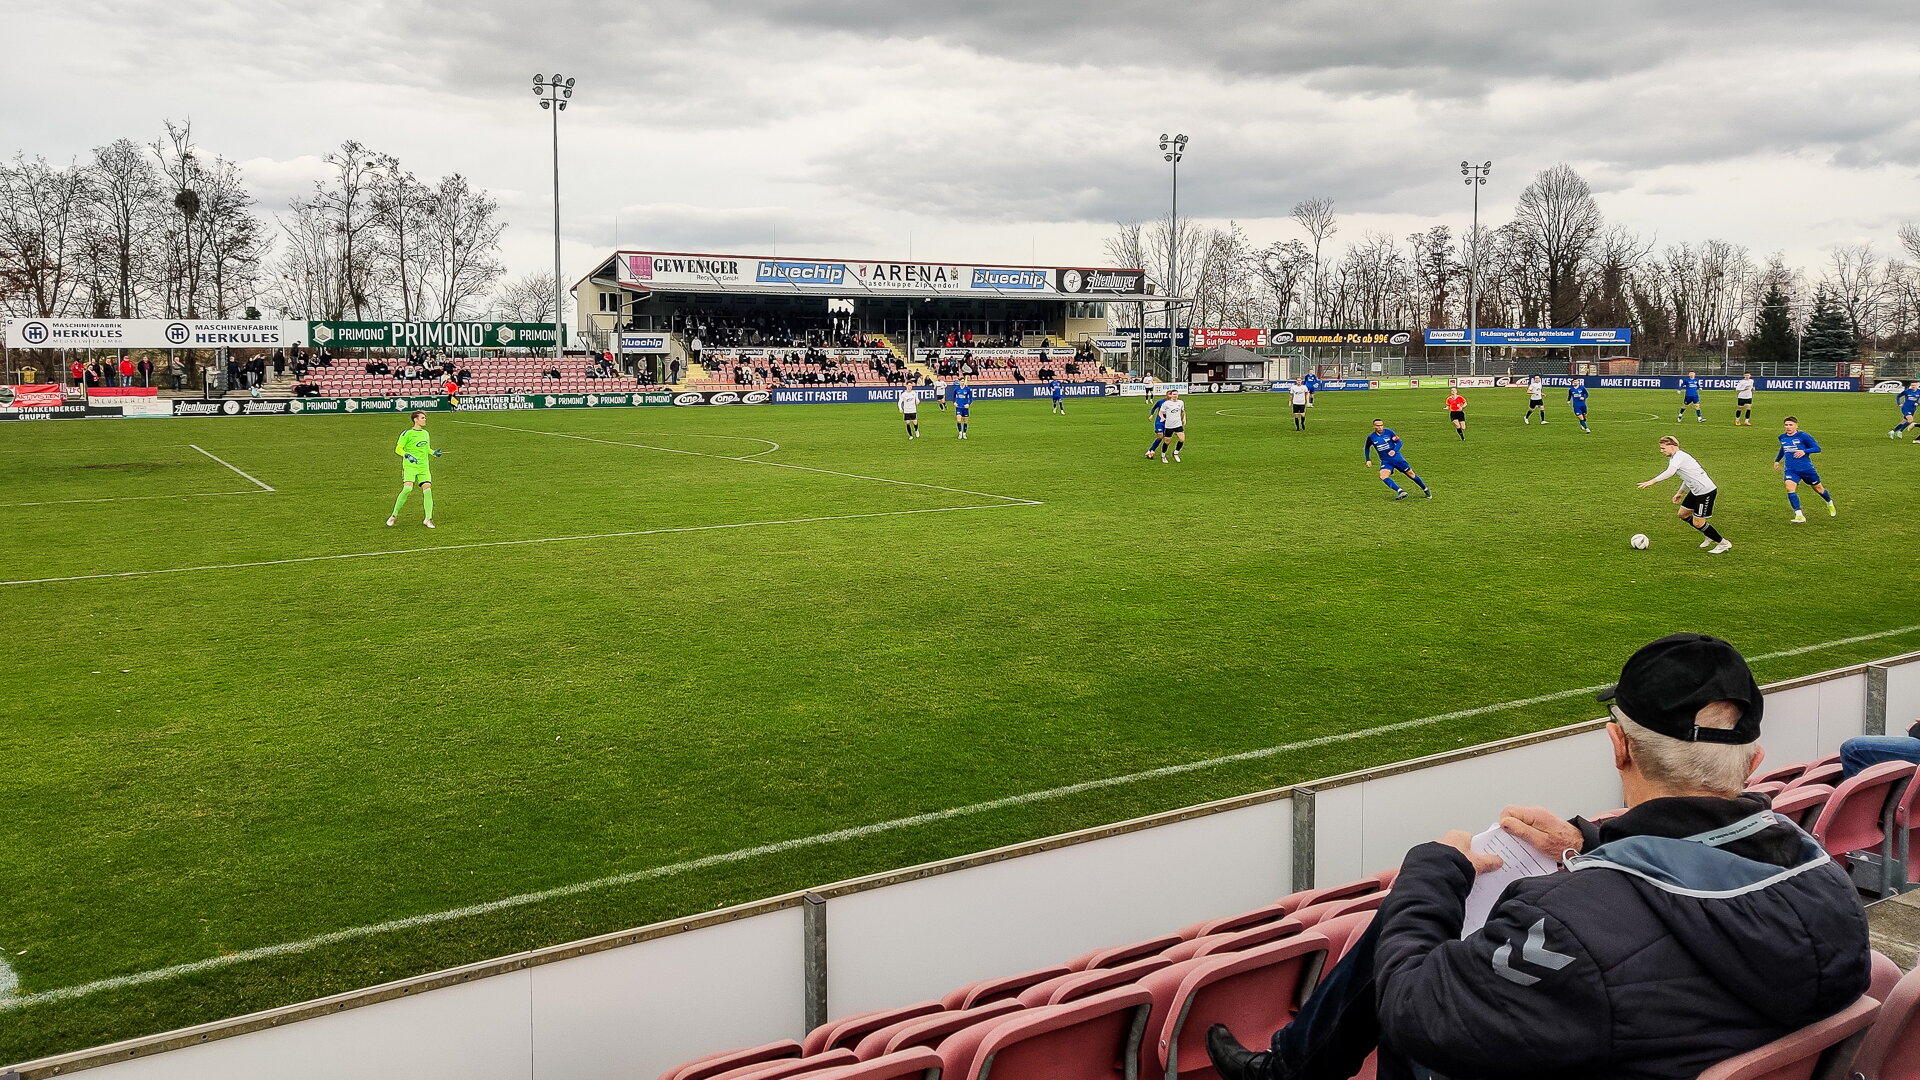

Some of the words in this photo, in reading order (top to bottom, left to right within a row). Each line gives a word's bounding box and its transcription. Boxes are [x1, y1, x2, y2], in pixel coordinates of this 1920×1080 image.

[654, 259, 738, 274] GEWENIGER
[760, 263, 843, 282] bluechip
[873, 265, 947, 282] ARENA
[974, 270, 1044, 288] bluechip
[53, 330, 122, 338] HERKULES
[195, 333, 279, 343] HERKULES
[1296, 334, 1342, 343] www.one.de
[1347, 334, 1361, 343] PCs
[1362, 334, 1373, 343] ab
[1374, 334, 1389, 343] 99€
[1552, 378, 1559, 386] IT
[1601, 379, 1621, 387] MAKE
[1622, 379, 1631, 387] IT
[1632, 379, 1660, 387] BETTER
[1705, 380, 1713, 388] IT
[1714, 380, 1738, 388] EASIE
[1766, 380, 1793, 389] MAKE
[1795, 380, 1804, 389] IT
[1805, 381, 1850, 390] SMARTER
[776, 391, 803, 401] MAKE
[805, 391, 814, 401] IT
[815, 391, 848, 401] FASTER
[868, 390, 893, 400] MAKE
[979, 388, 986, 397] IT
[988, 387, 1014, 397] EASIER
[1065, 386, 1100, 396] SMARTER
[475, 396, 509, 404] PARTNER
[511, 395, 525, 404] FÜR
